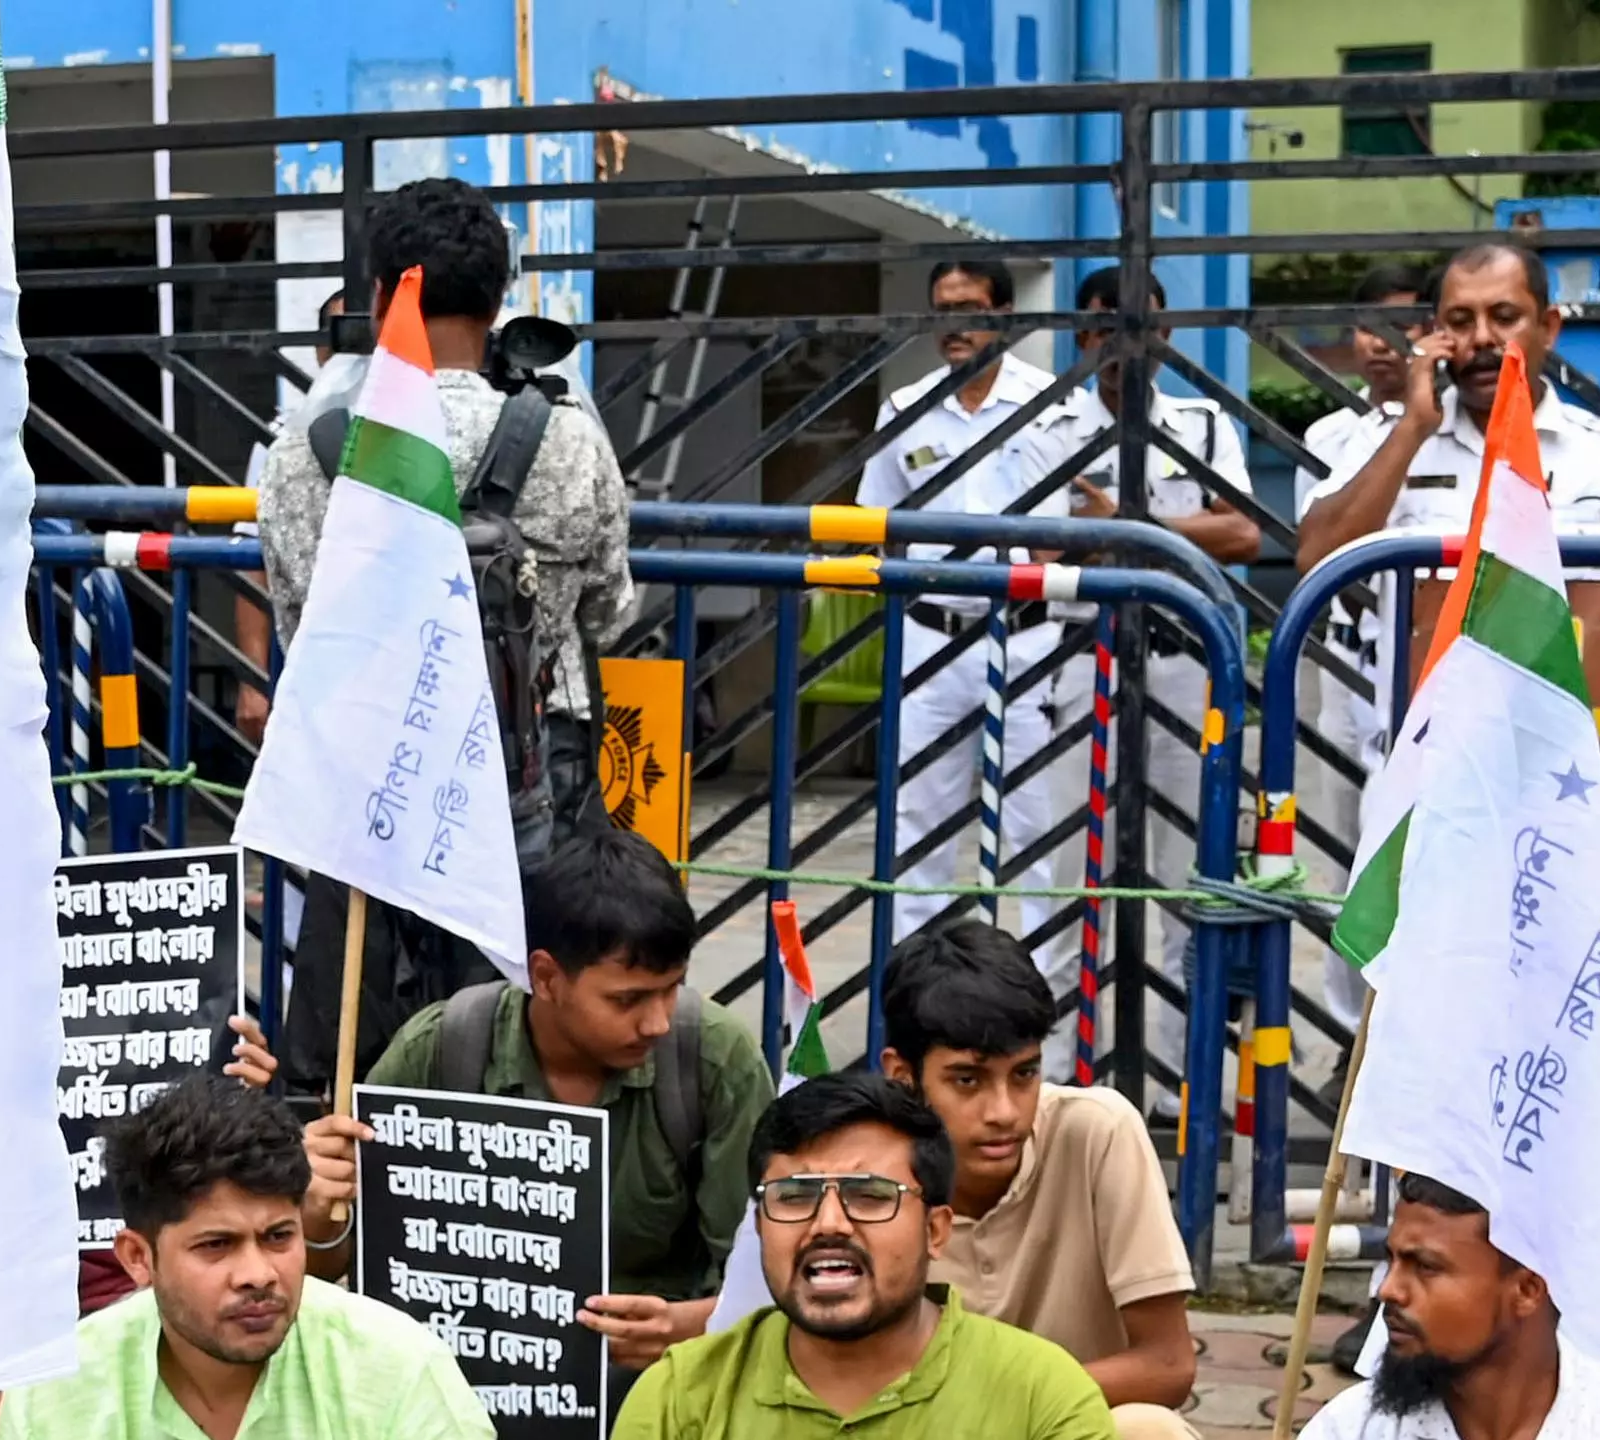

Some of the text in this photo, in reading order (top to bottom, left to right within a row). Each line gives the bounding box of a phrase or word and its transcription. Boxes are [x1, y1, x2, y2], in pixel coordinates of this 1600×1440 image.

[104, 863, 228, 927] মুখ্যমন্ত্রীর
[136, 925, 215, 965] বাংলার
[125, 1030, 167, 1070] বার
[169, 1027, 212, 1067] বার
[370, 1103, 592, 1175] মহিলা মুখ্যমন্ত্রীর
[386, 1164, 577, 1224] আমলে বাংলার
[402, 1217, 562, 1273] মা-বোনেদের
[481, 1276, 528, 1320] বার
[529, 1284, 576, 1328] বার
[490, 1329, 564, 1373] কেন?
